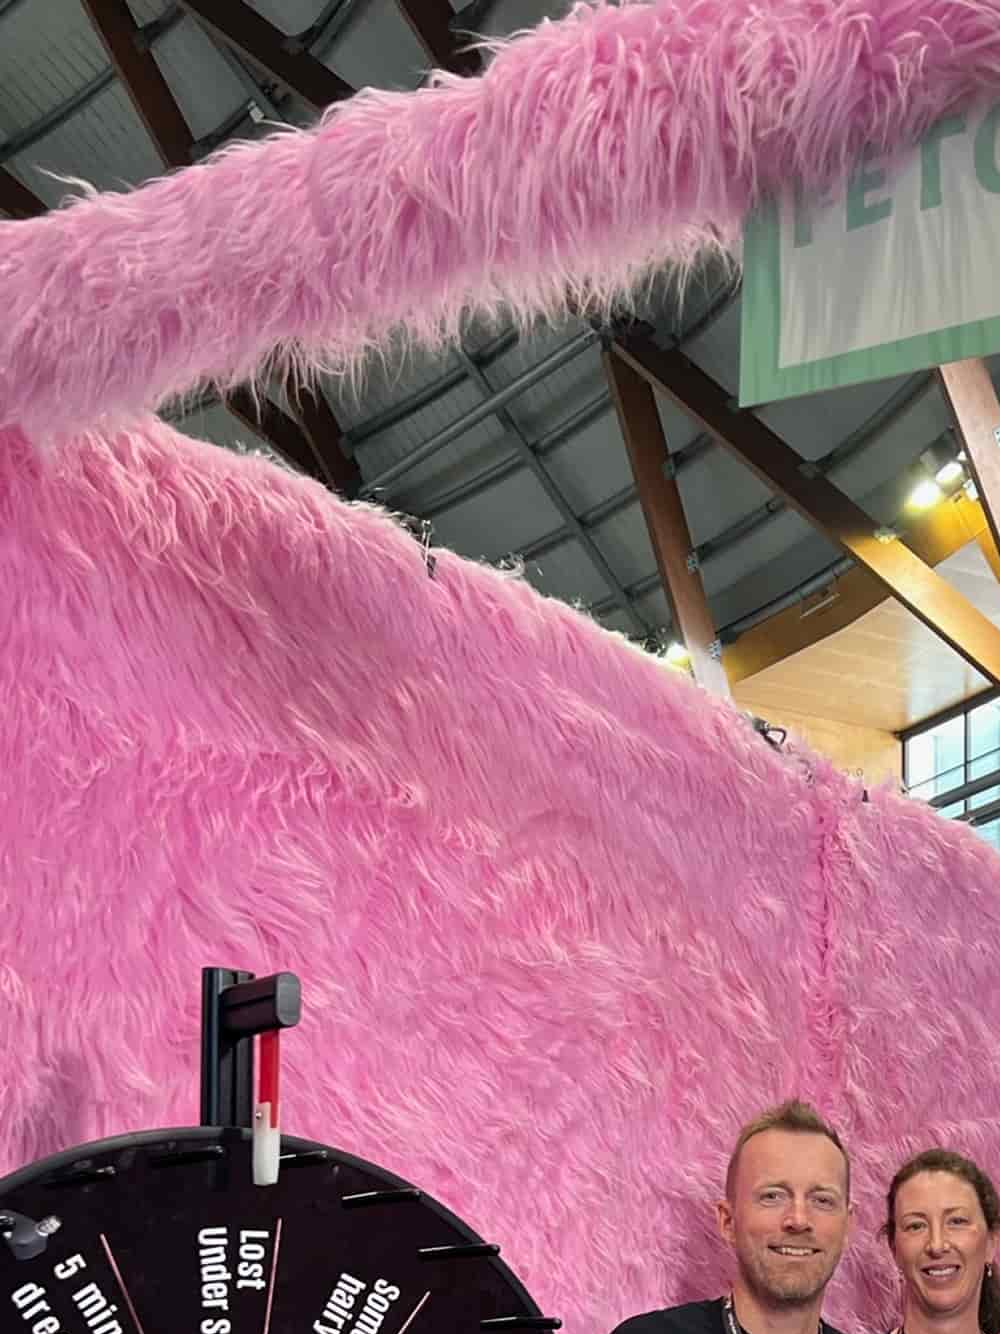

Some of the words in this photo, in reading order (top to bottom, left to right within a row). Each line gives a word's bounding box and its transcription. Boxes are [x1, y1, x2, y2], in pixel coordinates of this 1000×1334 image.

[53, 1253, 87, 1280] 5
[198, 1226, 232, 1311] Under
[237, 1229, 270, 1290] Lost
